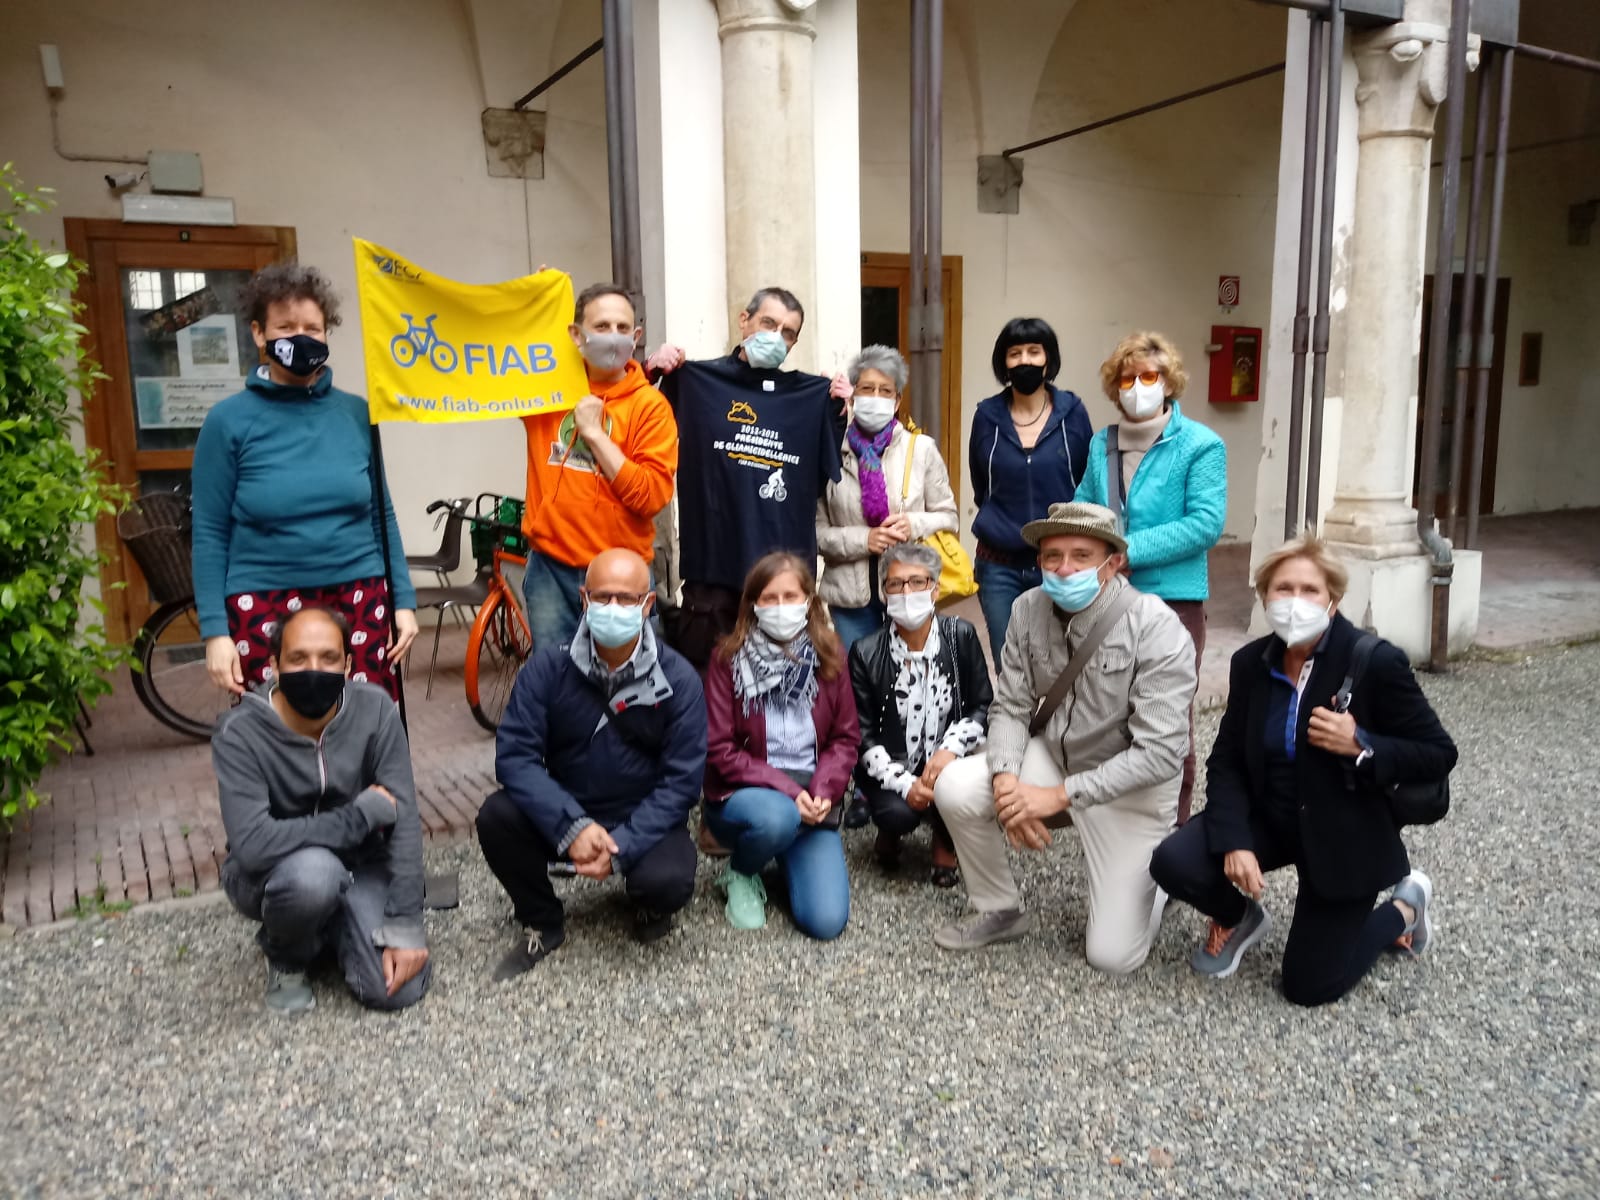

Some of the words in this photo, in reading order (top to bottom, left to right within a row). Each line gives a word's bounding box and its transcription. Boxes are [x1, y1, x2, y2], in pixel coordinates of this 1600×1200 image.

[463, 343, 557, 376] FIAB
[714, 440, 725, 449] DE
[735, 433, 784, 450] PRESIDENTE
